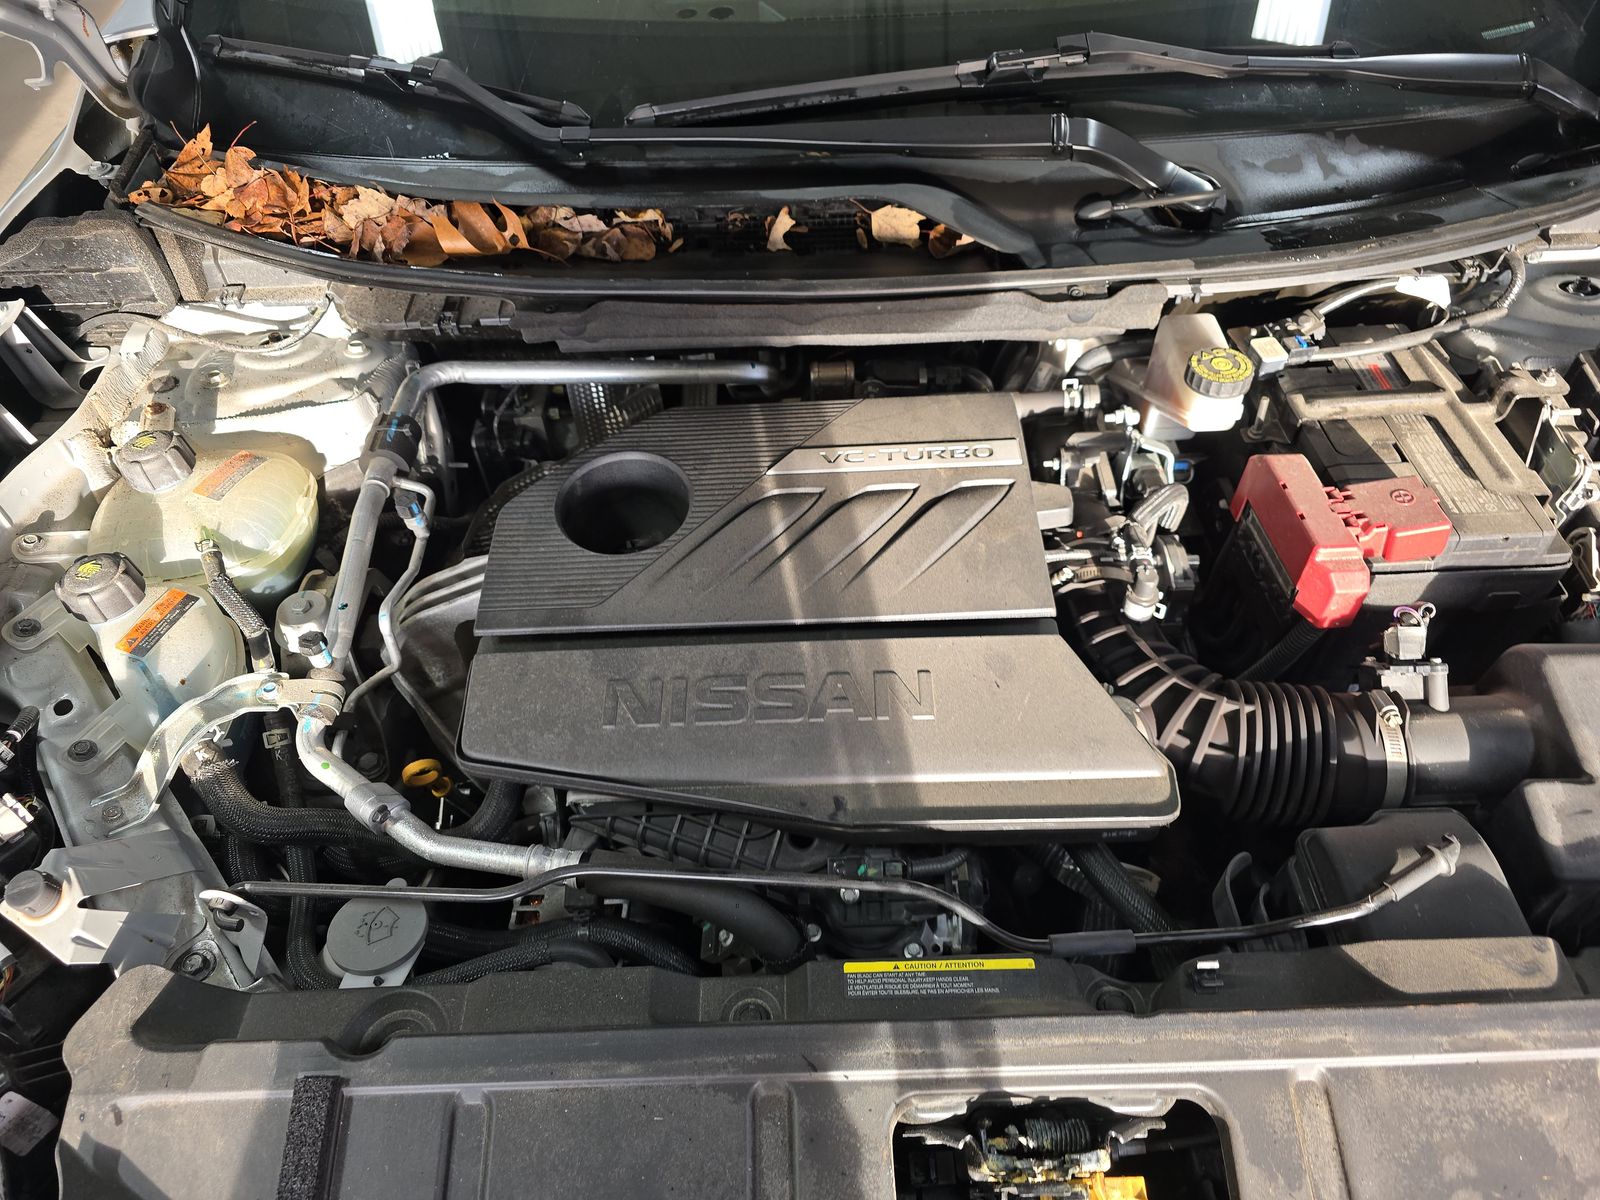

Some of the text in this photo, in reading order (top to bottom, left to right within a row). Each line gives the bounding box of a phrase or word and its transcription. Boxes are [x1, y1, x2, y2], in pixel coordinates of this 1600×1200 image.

[819, 444, 994, 463] VC-TURBO
[601, 670, 936, 728] NISSAN
[944, 961, 985, 969] ATTENTION
